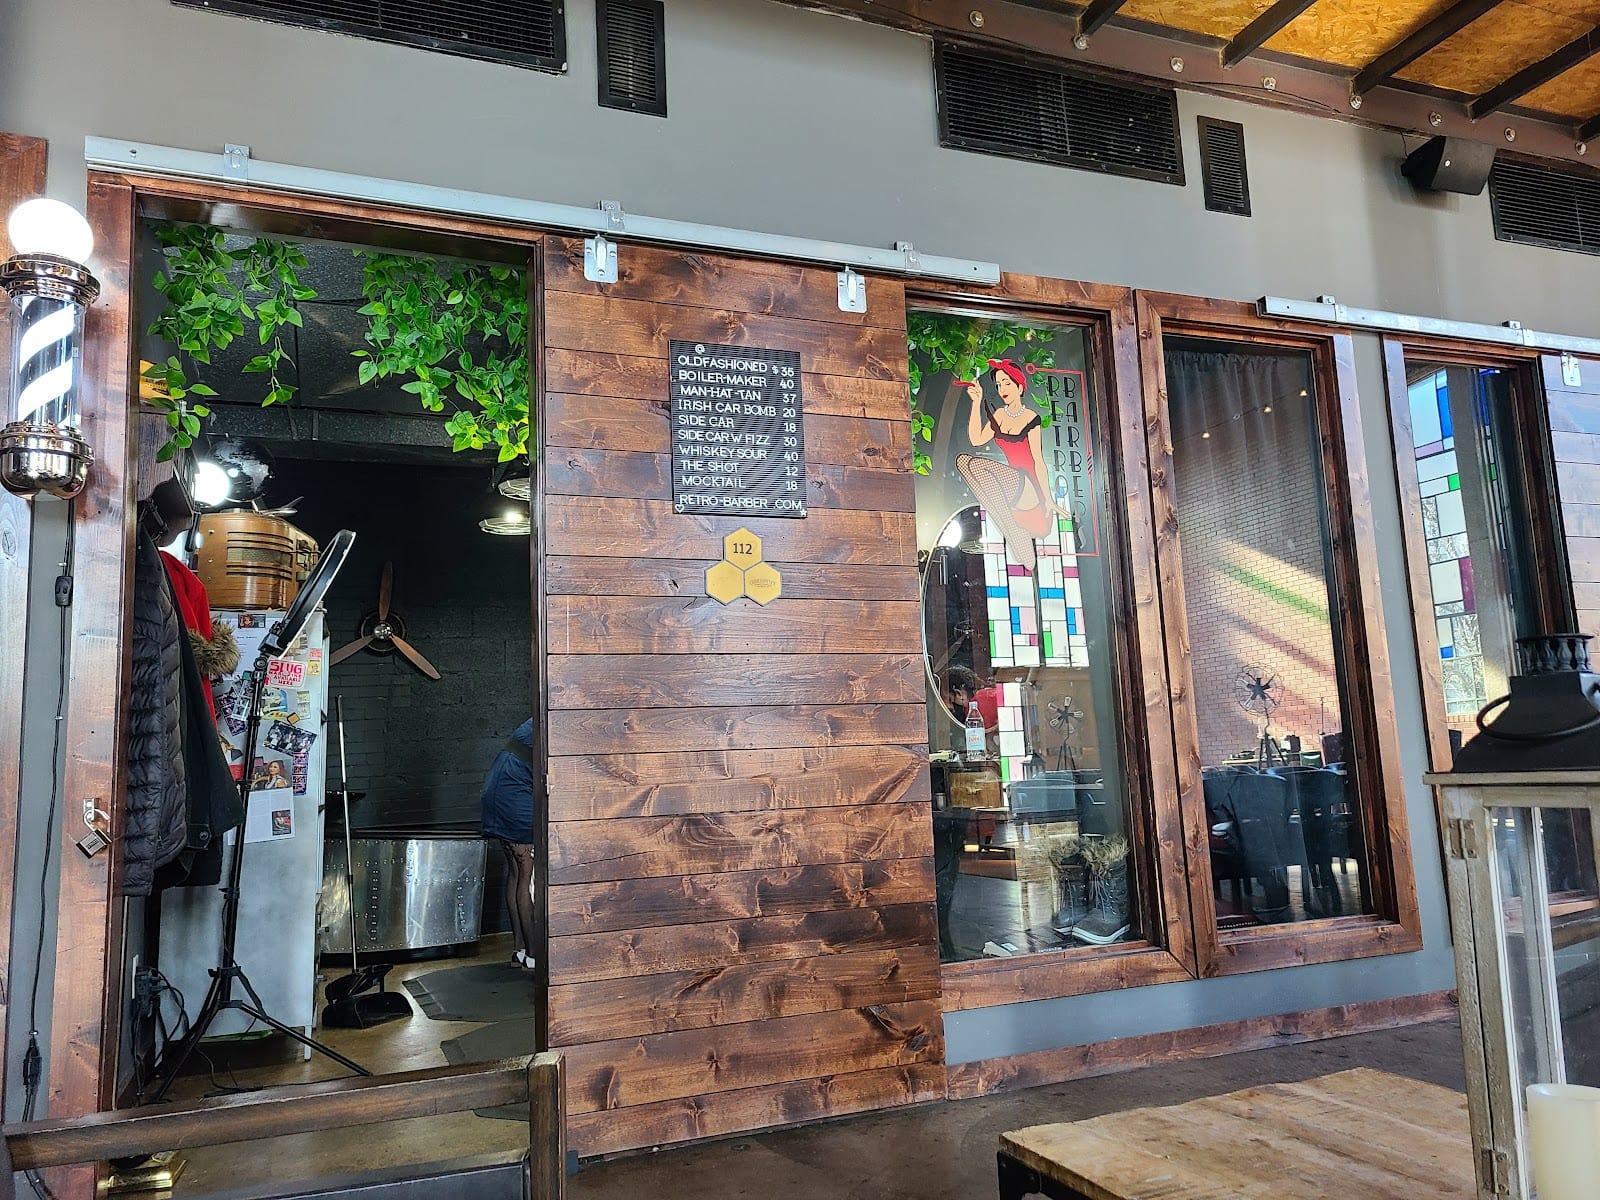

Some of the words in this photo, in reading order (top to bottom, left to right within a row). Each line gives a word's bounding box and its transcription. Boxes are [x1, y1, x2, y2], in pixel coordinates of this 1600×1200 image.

[678, 355, 768, 373] OLDFASHIONED
[678, 370, 768, 387] BOILER-MAKER
[780, 380, 794, 389] 40
[782, 393, 797, 404] 37
[678, 399, 712, 412] IRISH
[715, 402, 741, 413] CAR
[744, 404, 777, 417] BOMB
[782, 408, 796, 418] 20
[678, 415, 706, 426] SIDE
[709, 416, 735, 428] CAR
[784, 422, 796, 433] 18
[678, 430, 704, 441] SIDE
[705, 432, 730, 443] CAR
[730, 434, 743, 443] W
[745, 435, 771, 445] FIZZ
[783, 437, 797, 447] 30
[678, 445, 735, 459] WHISKEY
[736, 449, 768, 459] SOUR
[784, 452, 799, 462] 40
[680, 460, 704, 471] THE
[707, 461, 740, 473] SHOT
[785, 466, 799, 477] 12
[682, 475, 747, 488] MOCKTAIL
[786, 481, 798, 491] 18
[733, 543, 753, 555] 112
